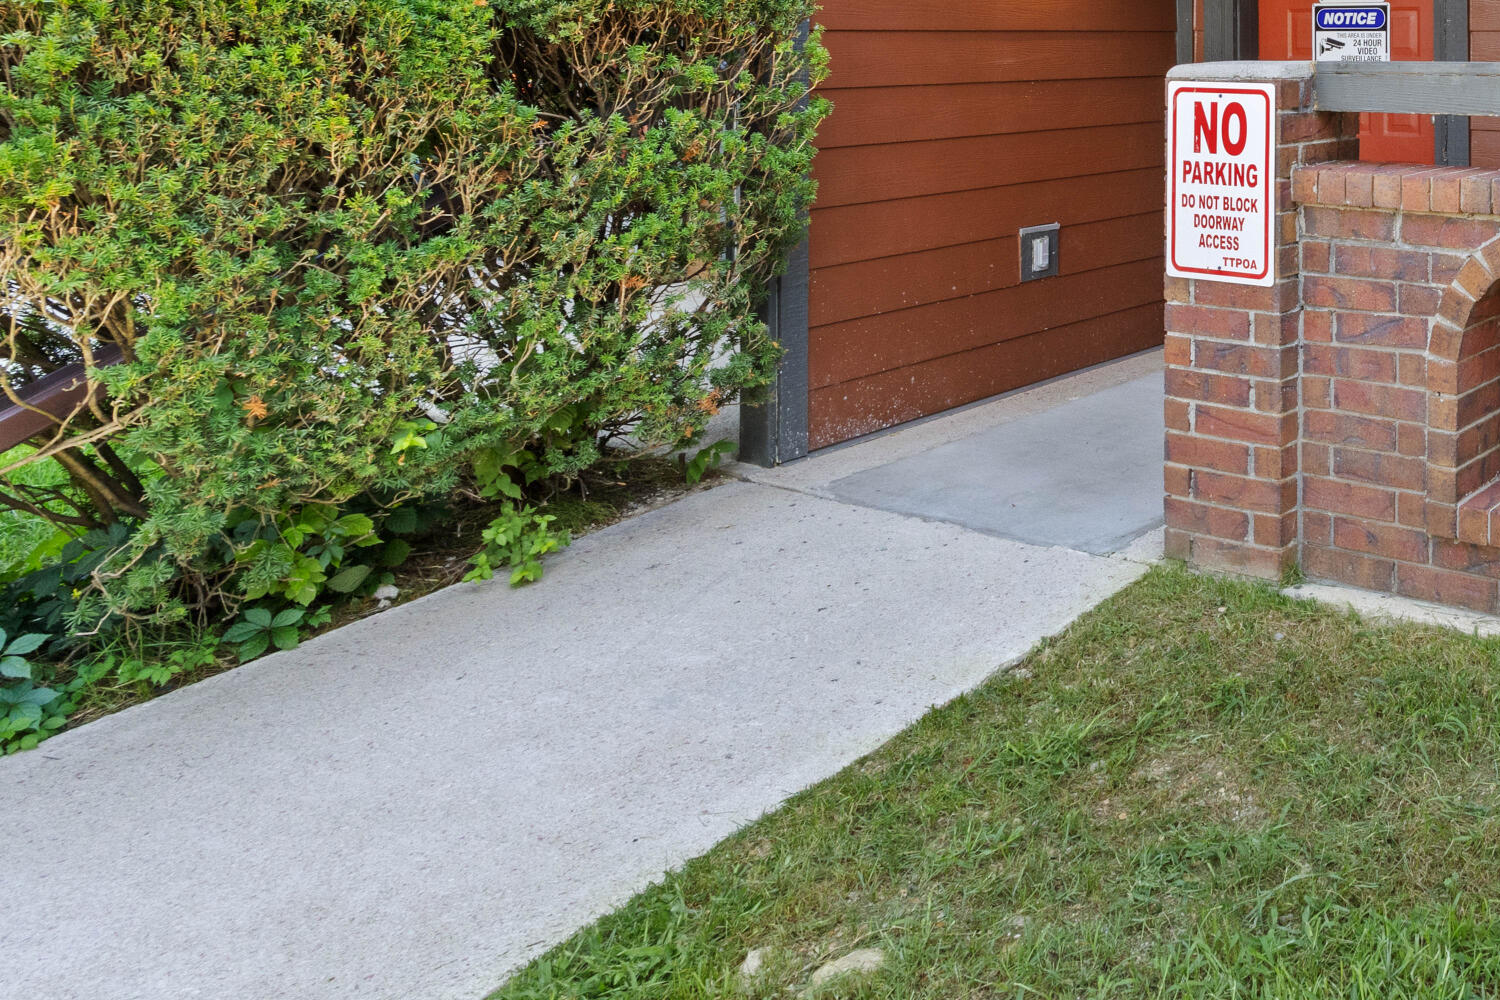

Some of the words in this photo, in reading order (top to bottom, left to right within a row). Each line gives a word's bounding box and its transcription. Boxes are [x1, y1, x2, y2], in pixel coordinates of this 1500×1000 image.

[1323, 12, 1377, 25] NOTICE
[1353, 39, 1361, 47] 24
[1363, 39, 1382, 47] HOUR
[1357, 47, 1378, 55] VIDEO
[1193, 101, 1248, 156] NO
[1182, 160, 1258, 188] PARKING
[1181, 193, 1195, 208] DO
[1199, 194, 1220, 210] NOT
[1223, 196, 1258, 213] BLOCK
[1193, 213, 1245, 231] DOORWAY
[1198, 233, 1239, 251] ACCESS
[1222, 256, 1257, 270] TTPOA
